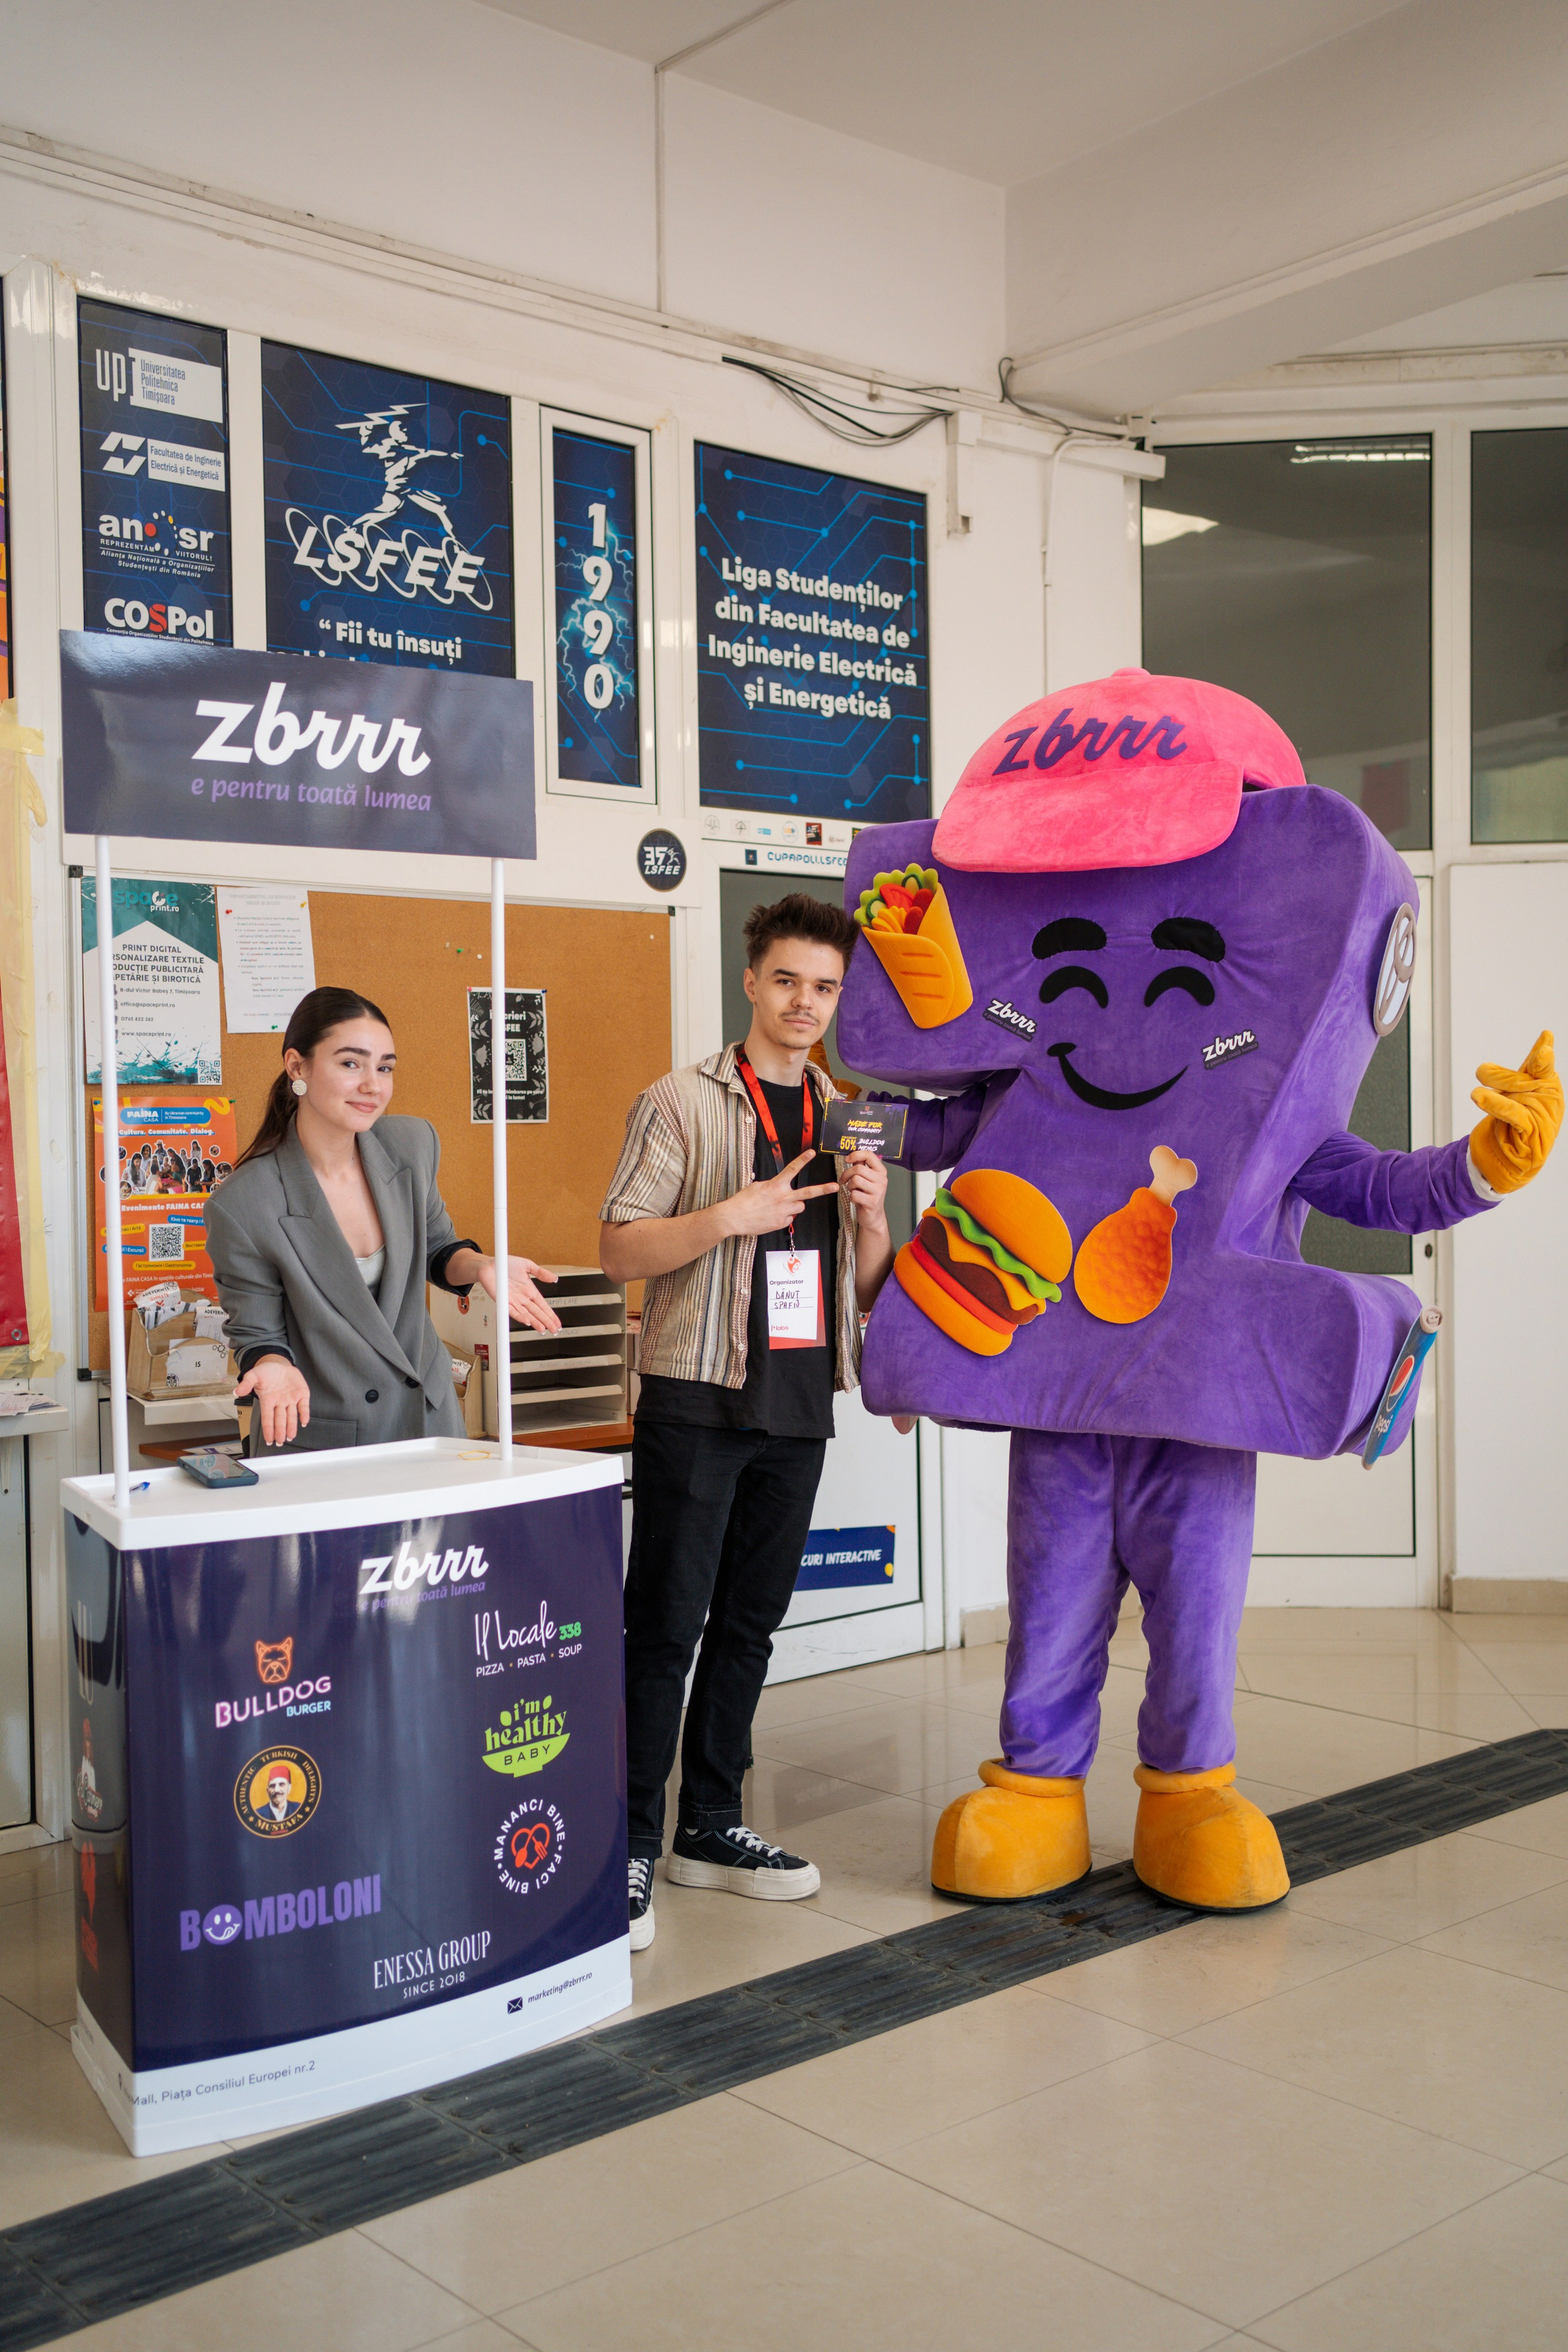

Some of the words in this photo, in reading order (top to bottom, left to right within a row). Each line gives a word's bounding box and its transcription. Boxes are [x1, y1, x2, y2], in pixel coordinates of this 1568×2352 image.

[141, 359, 186, 380] Universitatea
[141, 372, 178, 392] Politehnica
[141, 386, 175, 405] Timișoara
[150, 446, 184, 460] Facultatea
[185, 452, 193, 462] de
[194, 455, 221, 467] Inginerie
[151, 461, 178, 473] Electrică
[187, 469, 219, 481] Energetică
[175, 550, 213, 562] VIITORUL!
[293, 525, 486, 594] LSFEE
[172, 568, 201, 578] România
[721, 557, 772, 592] Liga
[776, 568, 903, 612] Studenților
[715, 594, 753, 625] din
[758, 603, 878, 644] Facultatea
[882, 624, 911, 649] de
[336, 621, 362, 644] Fii
[367, 627, 392, 649] tu
[396, 630, 461, 665] însuți
[707, 634, 815, 671] Inginerie
[818, 651, 918, 687] Electrică
[744, 676, 764, 710] și
[769, 682, 892, 720] Energetică
[191, 682, 431, 777] zbrrr
[992, 707, 1188, 775] zbrrr
[191, 777, 204, 795] e
[211, 778, 290, 802] pentru
[298, 783, 357, 806] toată
[364, 785, 432, 812] lumea
[644, 865, 681, 875] LSFEE
[151, 964, 204, 974] PUBLICITARĂ
[162, 975, 201, 984] BIROTICĂ
[987, 1000, 1036, 1033] zbrrr
[1202, 1031, 1255, 1061] zbrrr
[847, 1119, 867, 1128] MADE
[840, 1139, 857, 1151] 50%
[358, 1541, 489, 1595] zbrrr
[825, 1549, 883, 1565] INTERACTIVE
[371, 1593, 413, 1613] pentru
[417, 1586, 448, 1604] toată
[451, 1580, 486, 1597] lumea
[559, 1621, 582, 1640] 338
[476, 1662, 505, 1677] PIZZA
[517, 1653, 546, 1668] PASTA
[559, 1643, 582, 1658] SOUP
[216, 1675, 331, 1728] BULLDOG
[286, 1700, 331, 1717] BURGER
[484, 1710, 567, 1752] healthy
[260, 1751, 298, 1763] TURKISH
[504, 1744, 551, 1766] BABY
[255, 1813, 304, 1832] MUSTAFA
[494, 1798, 543, 1861] MANANCI
[546, 1804, 565, 1842] BINE
[499, 1869, 529, 1894] BINE
[535, 1853, 562, 1890] FACI
[374, 1947, 435, 1989] ENESSA
[438, 1930, 491, 1971] GROUP
[403, 1980, 435, 1999] SINCE
[439, 1970, 466, 1989] 2018
[527, 1972, 593, 2003] marketing@zbrrr.ro
[162, 2089, 192, 2101] Piața
[195, 2076, 244, 2095] Consiliul
[249, 2065, 292, 2084] Europei
[295, 2060, 316, 2075] nr.2
